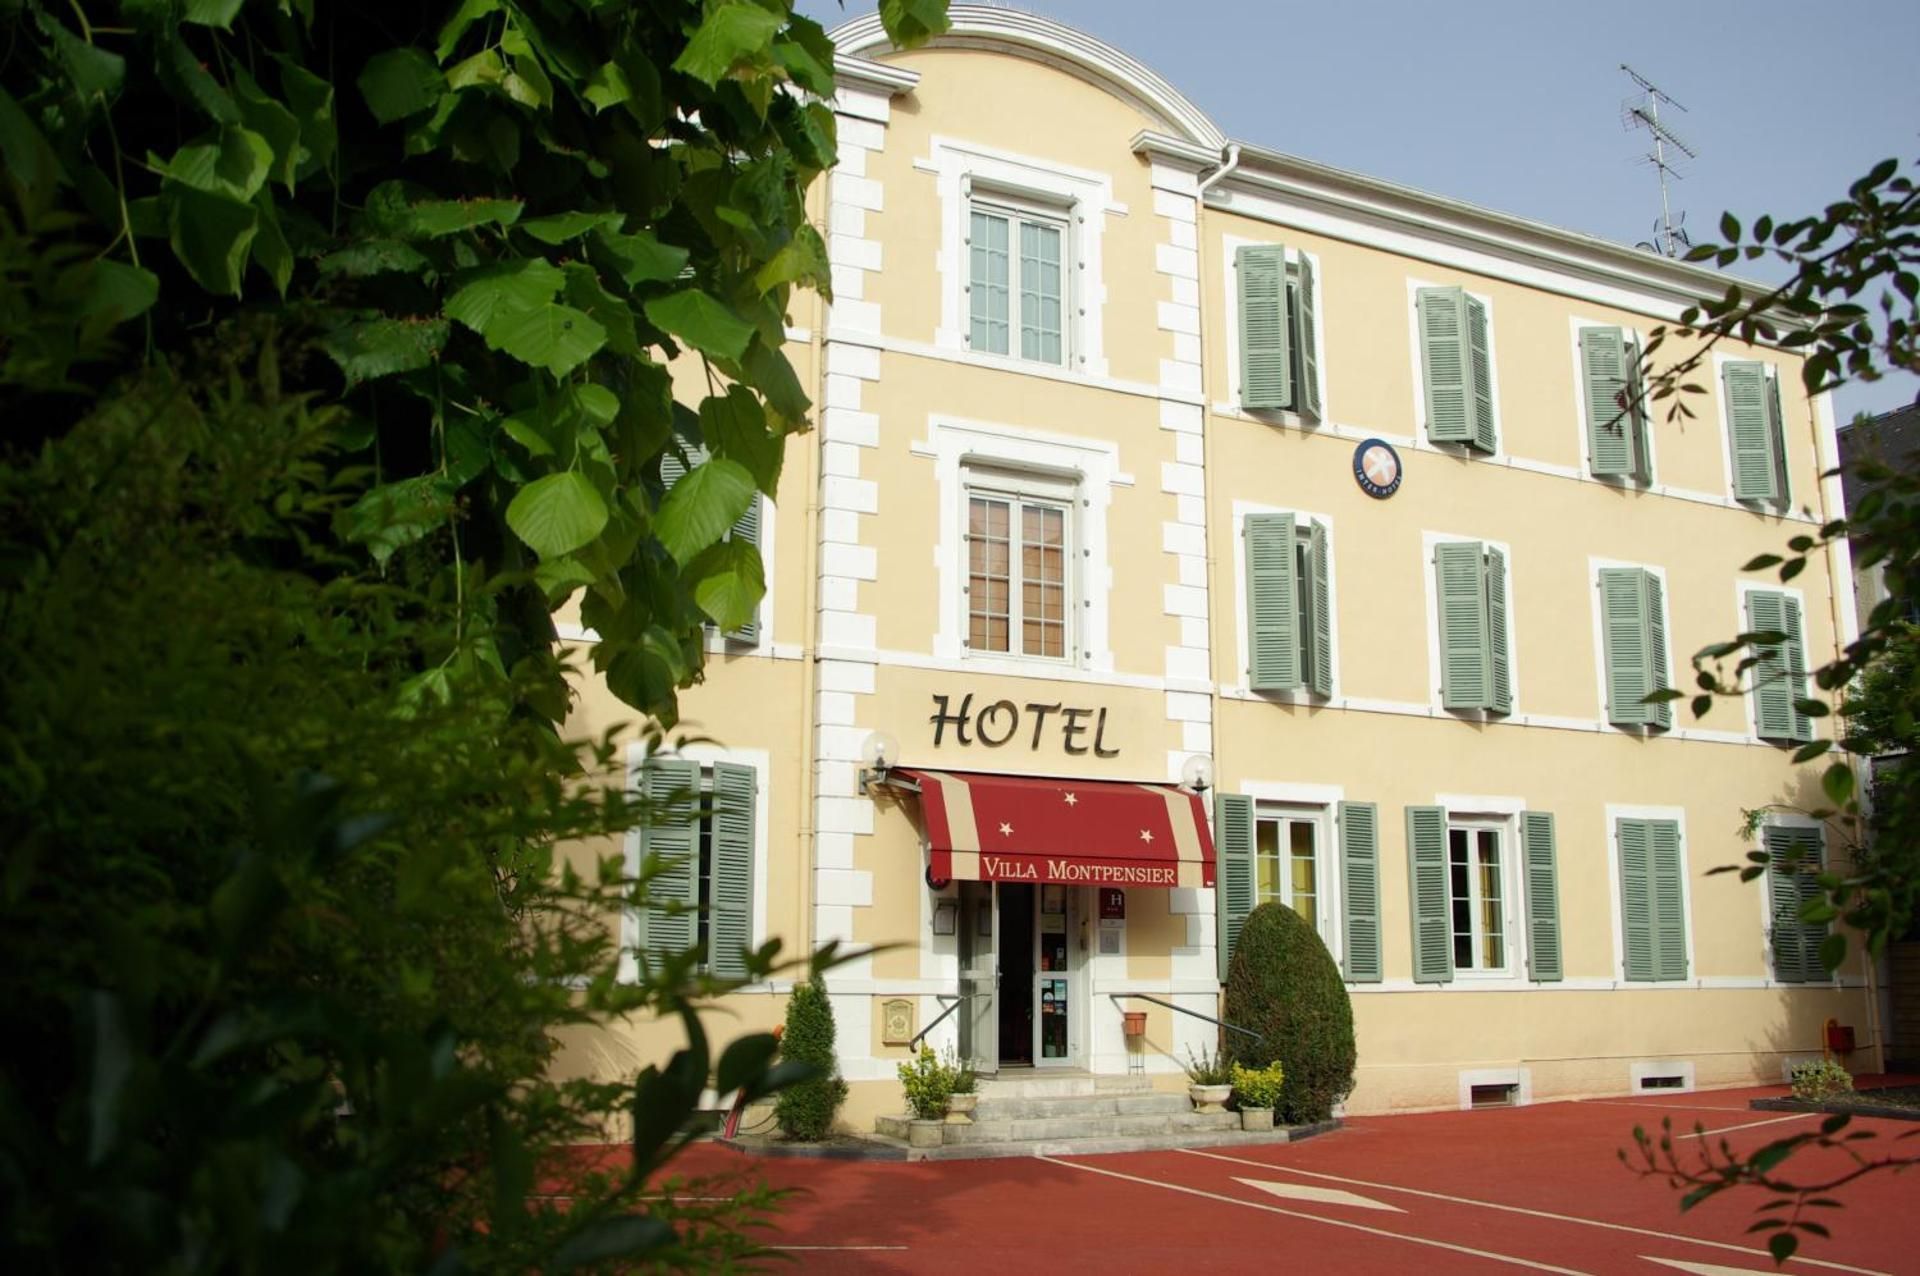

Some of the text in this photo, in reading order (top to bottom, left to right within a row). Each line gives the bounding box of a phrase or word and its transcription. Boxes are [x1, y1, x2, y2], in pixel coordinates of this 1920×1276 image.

[929, 692, 1121, 759] HOTEL
[982, 857, 1176, 884] VILLA MONTPENSIER
[1111, 894, 1122, 906] H
